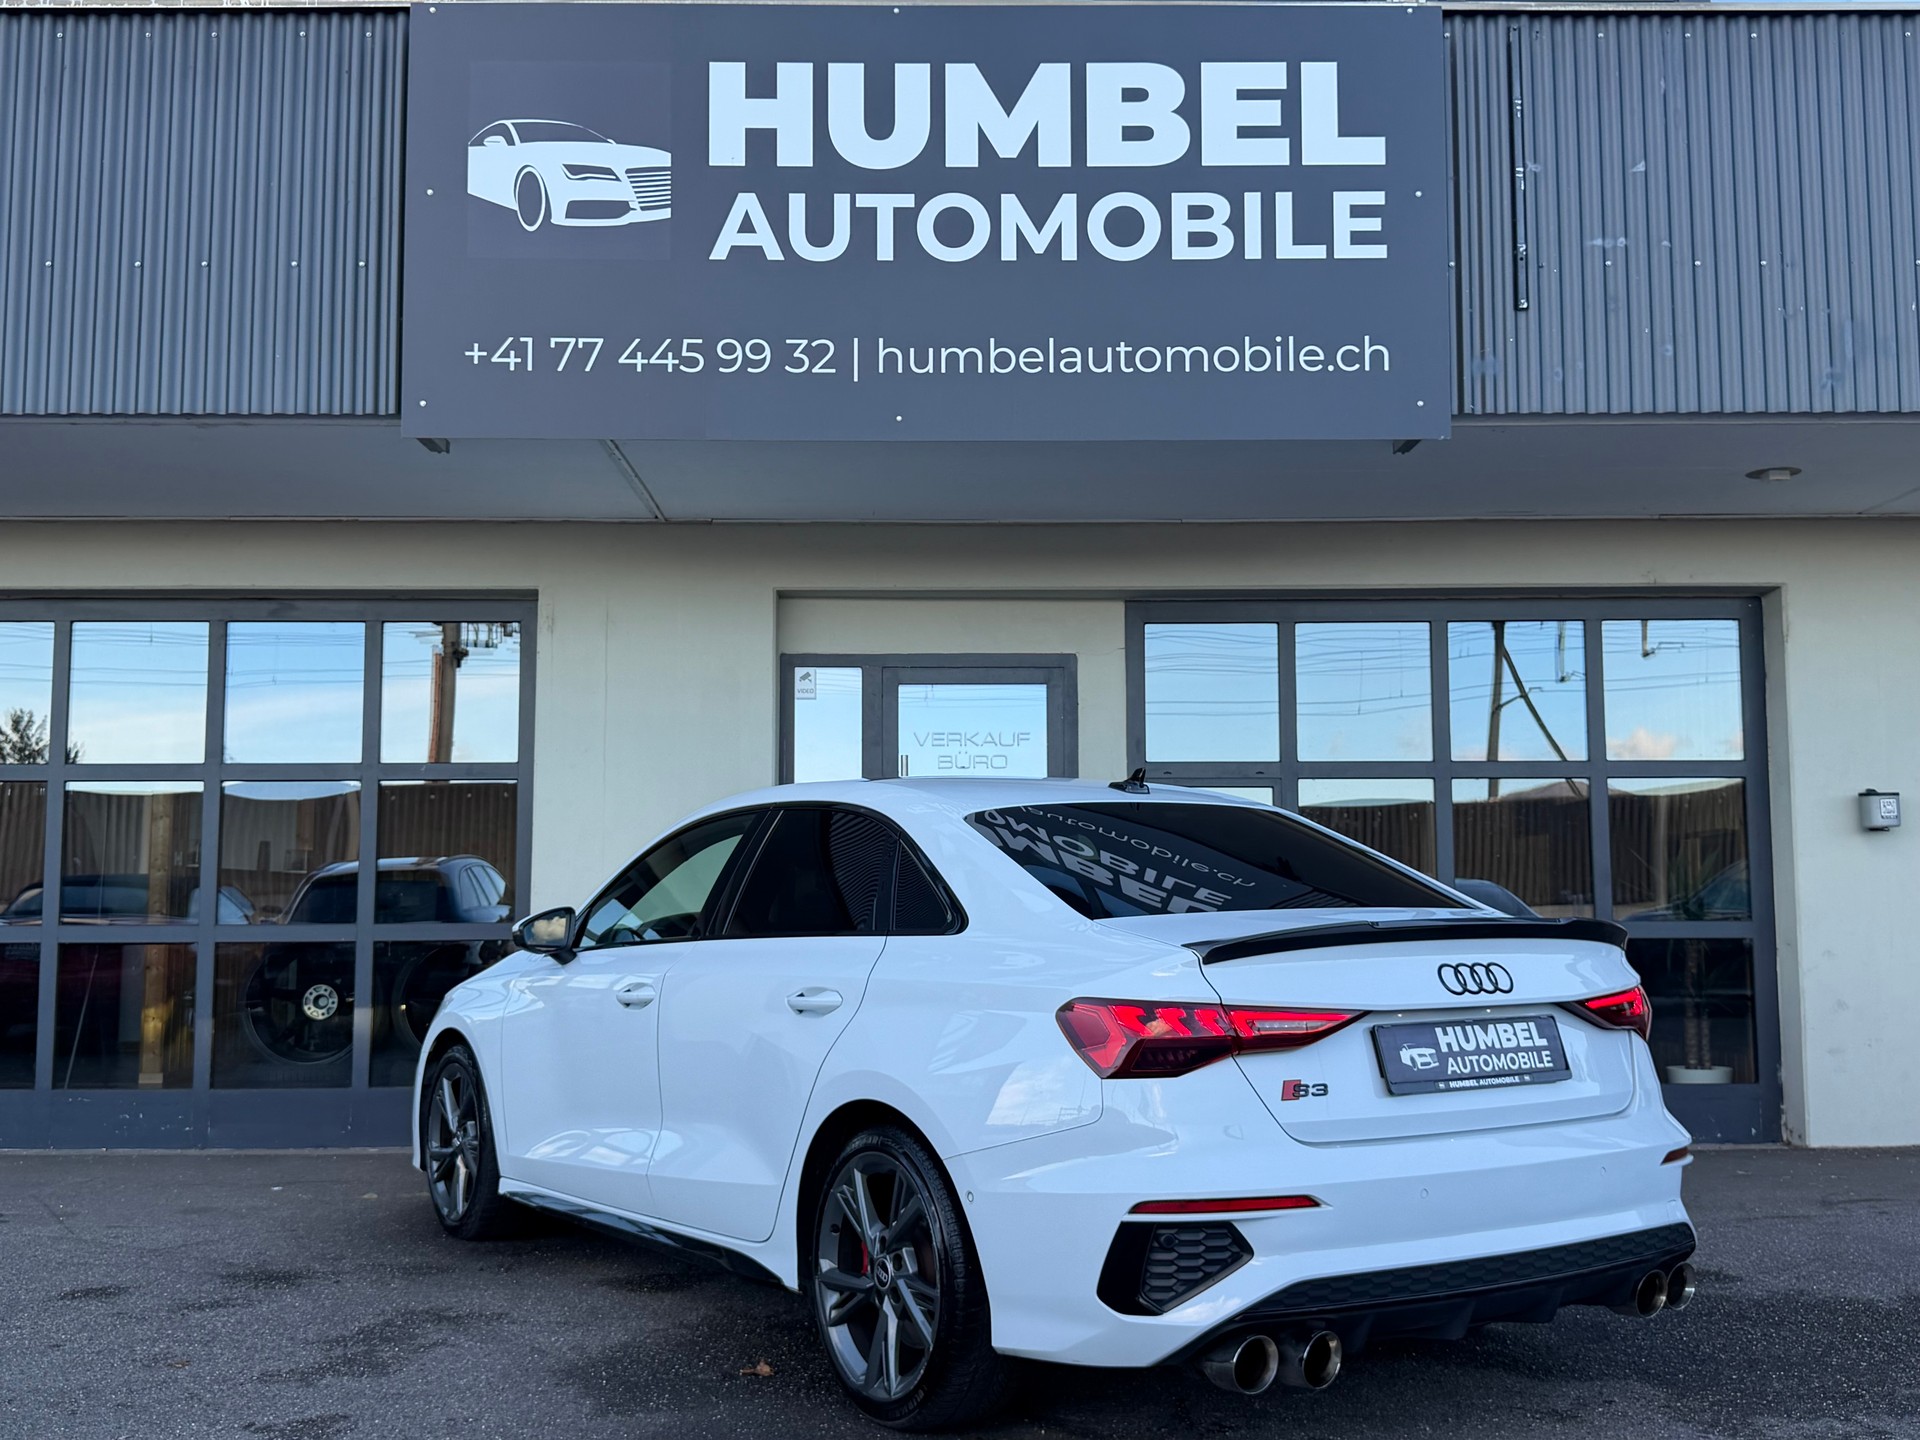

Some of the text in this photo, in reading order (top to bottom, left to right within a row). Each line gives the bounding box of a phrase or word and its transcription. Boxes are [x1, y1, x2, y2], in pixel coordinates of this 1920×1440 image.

[709, 61, 1387, 170] HUMBEL
[708, 191, 1388, 263] AUTOMOBILE
[464, 337, 533, 372] +41
[551, 338, 604, 372] 77
[618, 339, 705, 373] 445
[716, 339, 772, 374] 99
[784, 339, 837, 374] 32
[878, 335, 1390, 374] humbelautomobile.ch
[913, 731, 1031, 747] VERKAUF
[937, 751, 1008, 769] BÜRO
[1435, 1021, 1549, 1053] HUMBEL
[1447, 1050, 1554, 1075] AUTOMOBILE
[1292, 1083, 1329, 1098] S3
[1449, 1075, 1521, 1089] HUMBEL AUTOMOBILE
